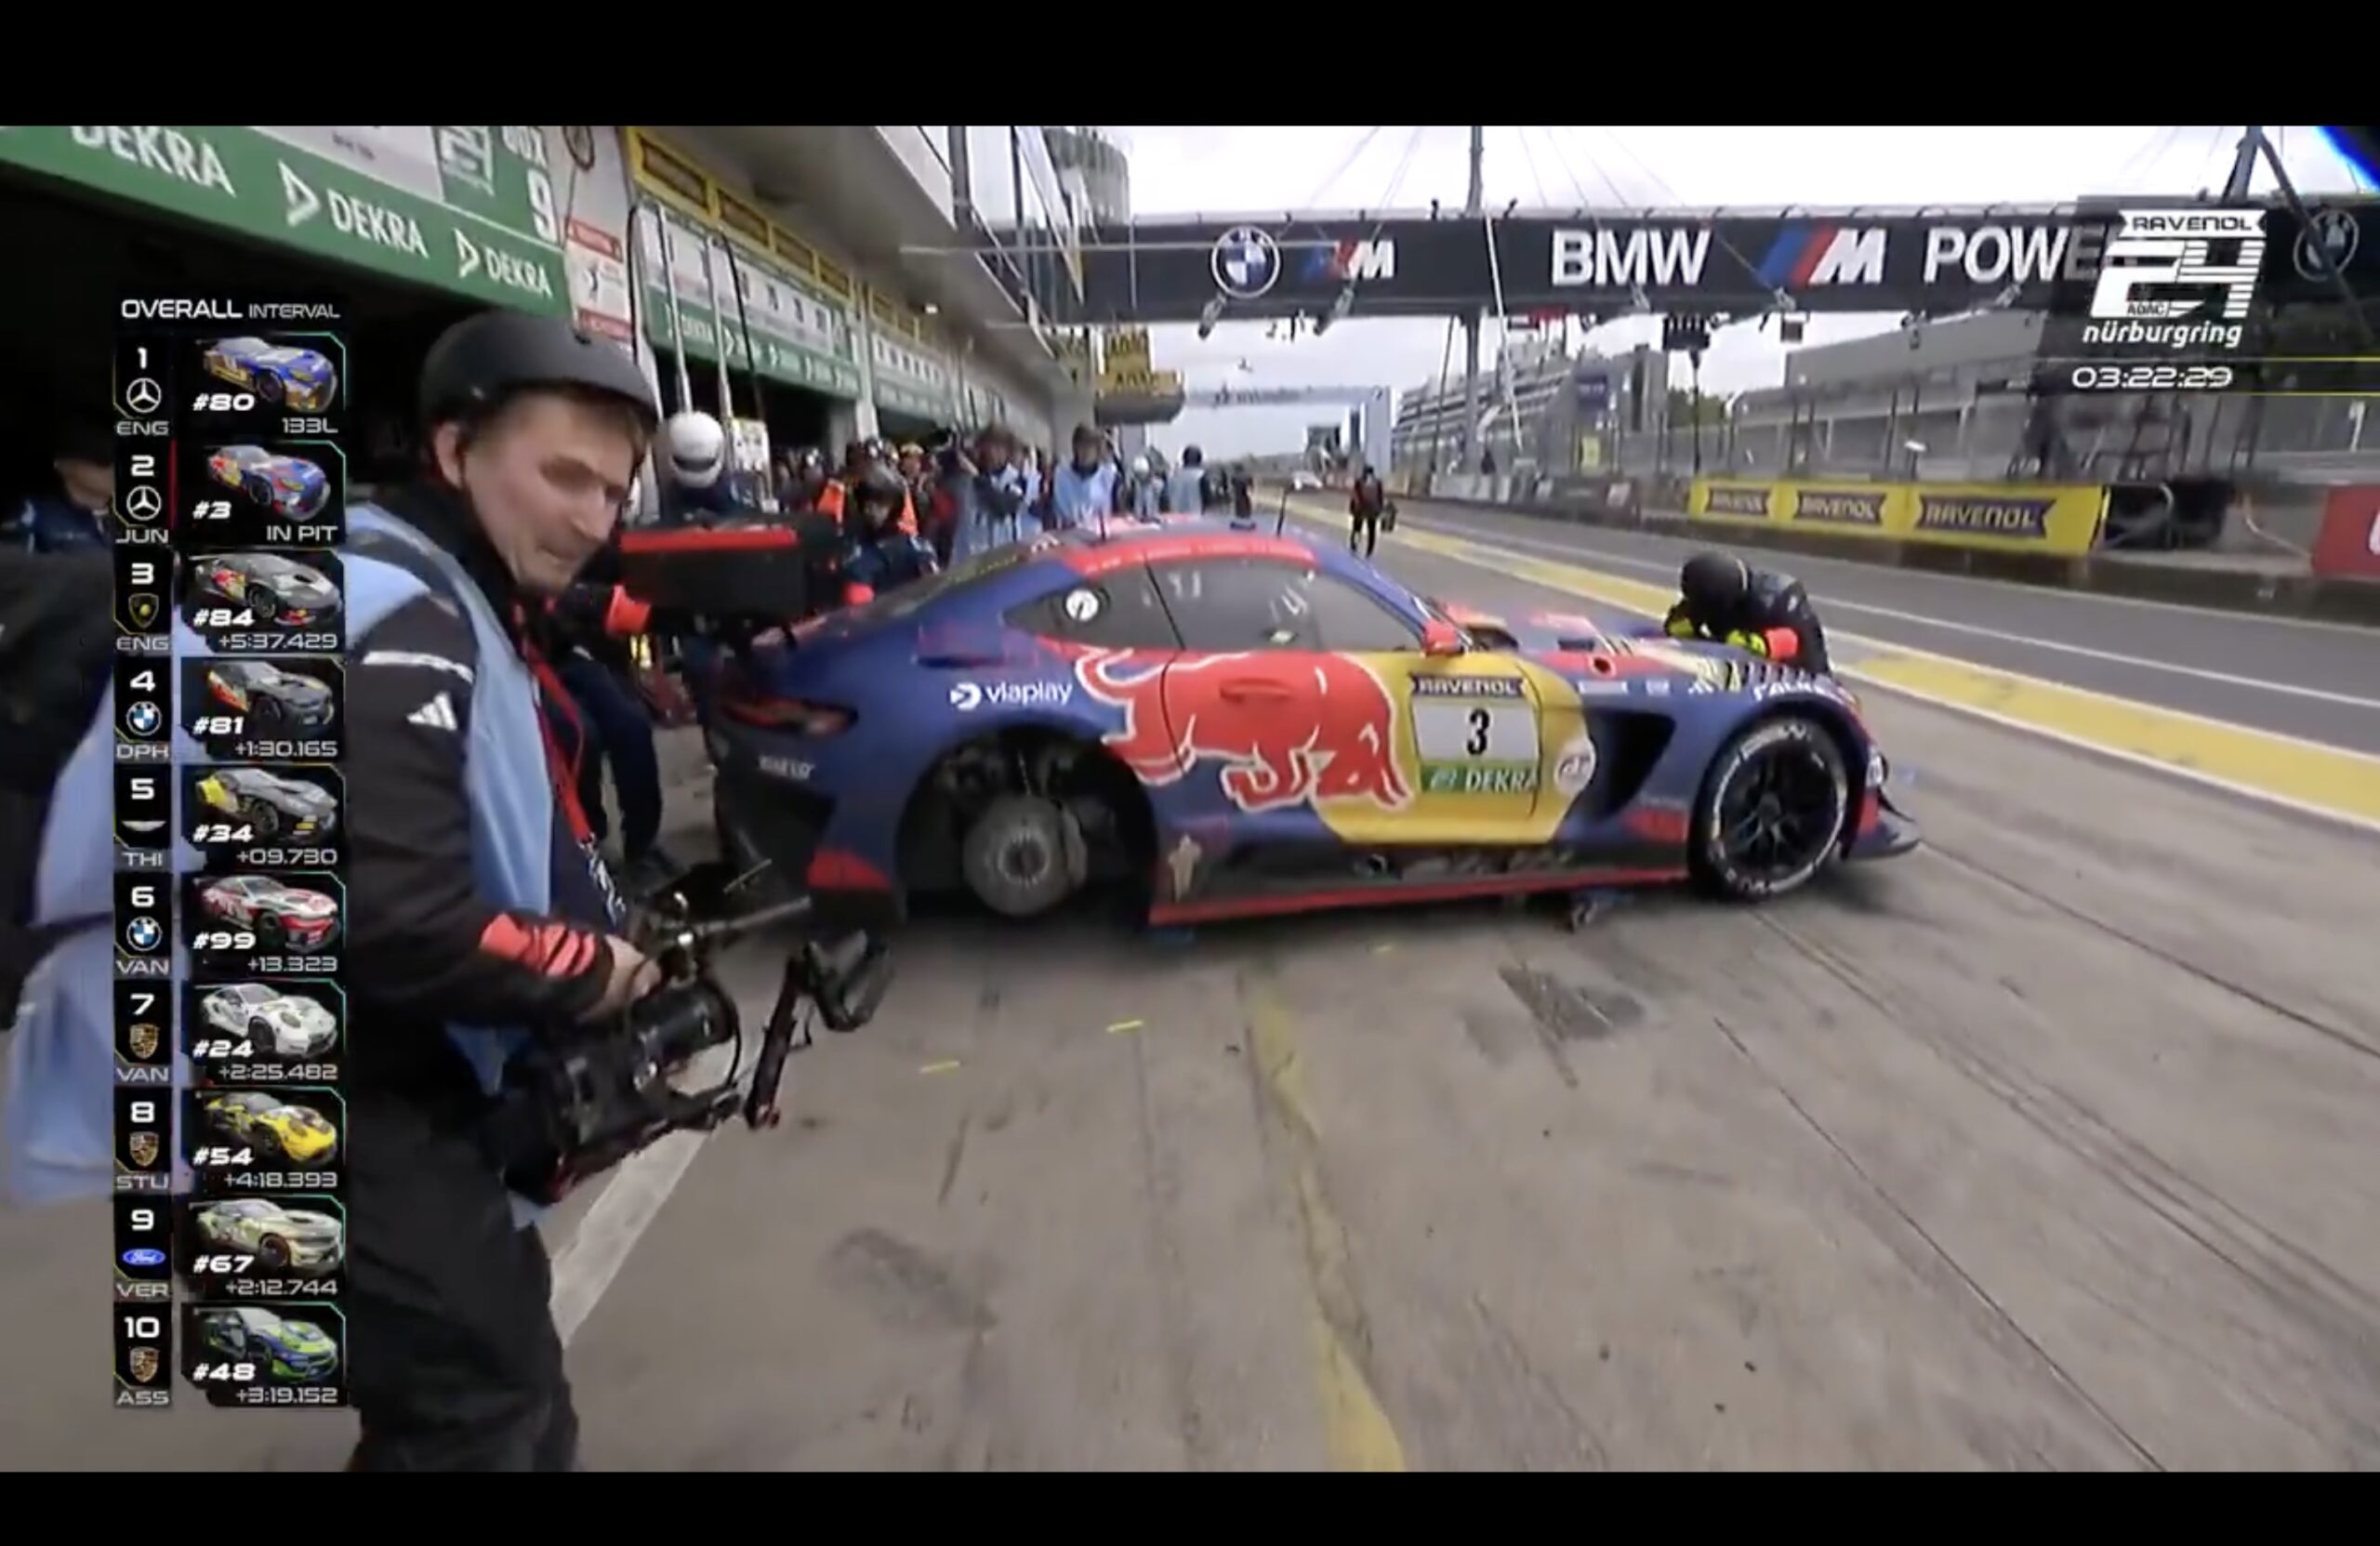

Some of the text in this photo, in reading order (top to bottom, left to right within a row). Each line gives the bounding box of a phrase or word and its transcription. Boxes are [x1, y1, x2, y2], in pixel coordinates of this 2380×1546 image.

[328, 189, 429, 258] DEKRA
[528, 168, 558, 244] 9
[483, 245, 553, 299] DEKRA
[1551, 225, 2124, 286] BMW M POWE
[1802, 492, 1877, 521] RAVENOL
[1925, 498, 2035, 529] RAVENOL
[985, 680, 1074, 707] viaplay
[1419, 678, 1519, 695] RAVENOL
[1466, 708, 1491, 756] 3
